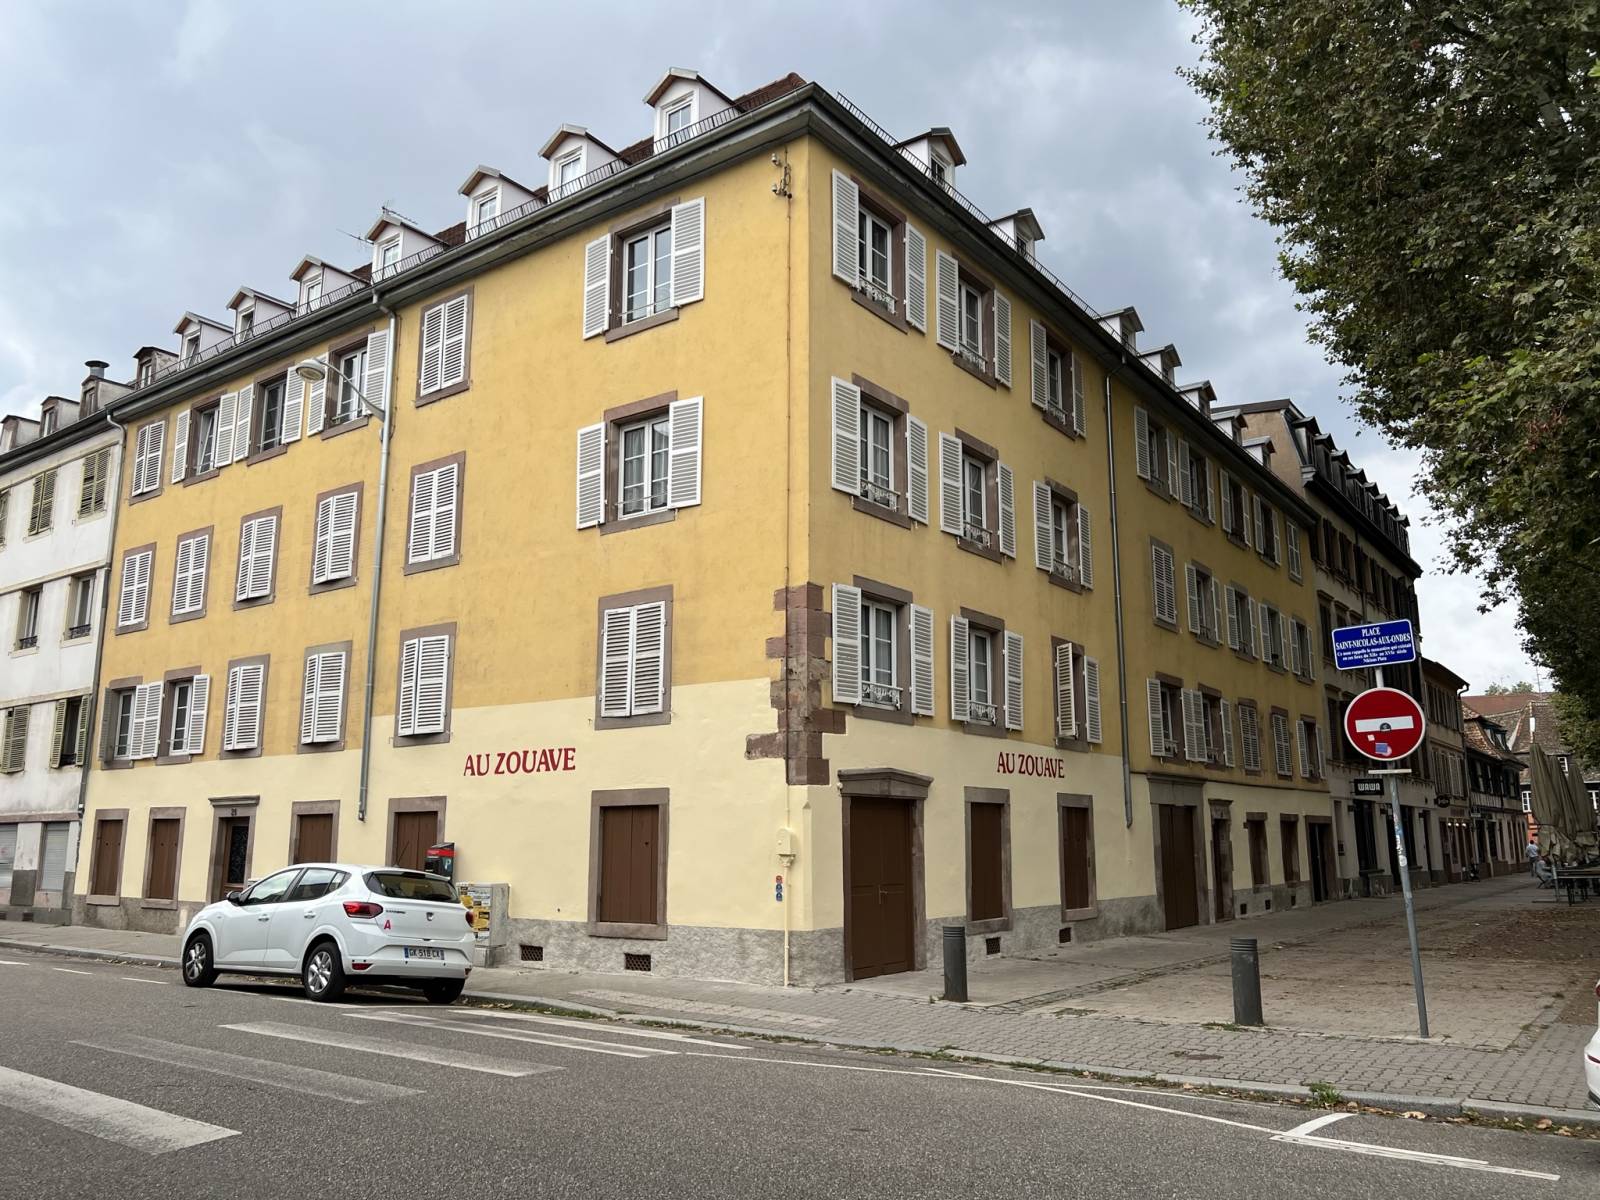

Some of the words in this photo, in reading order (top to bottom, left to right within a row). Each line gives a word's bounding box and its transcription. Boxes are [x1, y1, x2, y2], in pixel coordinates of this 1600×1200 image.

[1361, 627, 1380, 637] PLACE
[1335, 633, 1411, 650] SAINT-NICOLAS-AUX-ONDES
[463, 753, 491, 776] AU
[494, 747, 577, 775] ZOUAVE
[996, 752, 1015, 774] AU
[1018, 754, 1065, 779] ZOUAVE
[384, 920, 392, 930] A
